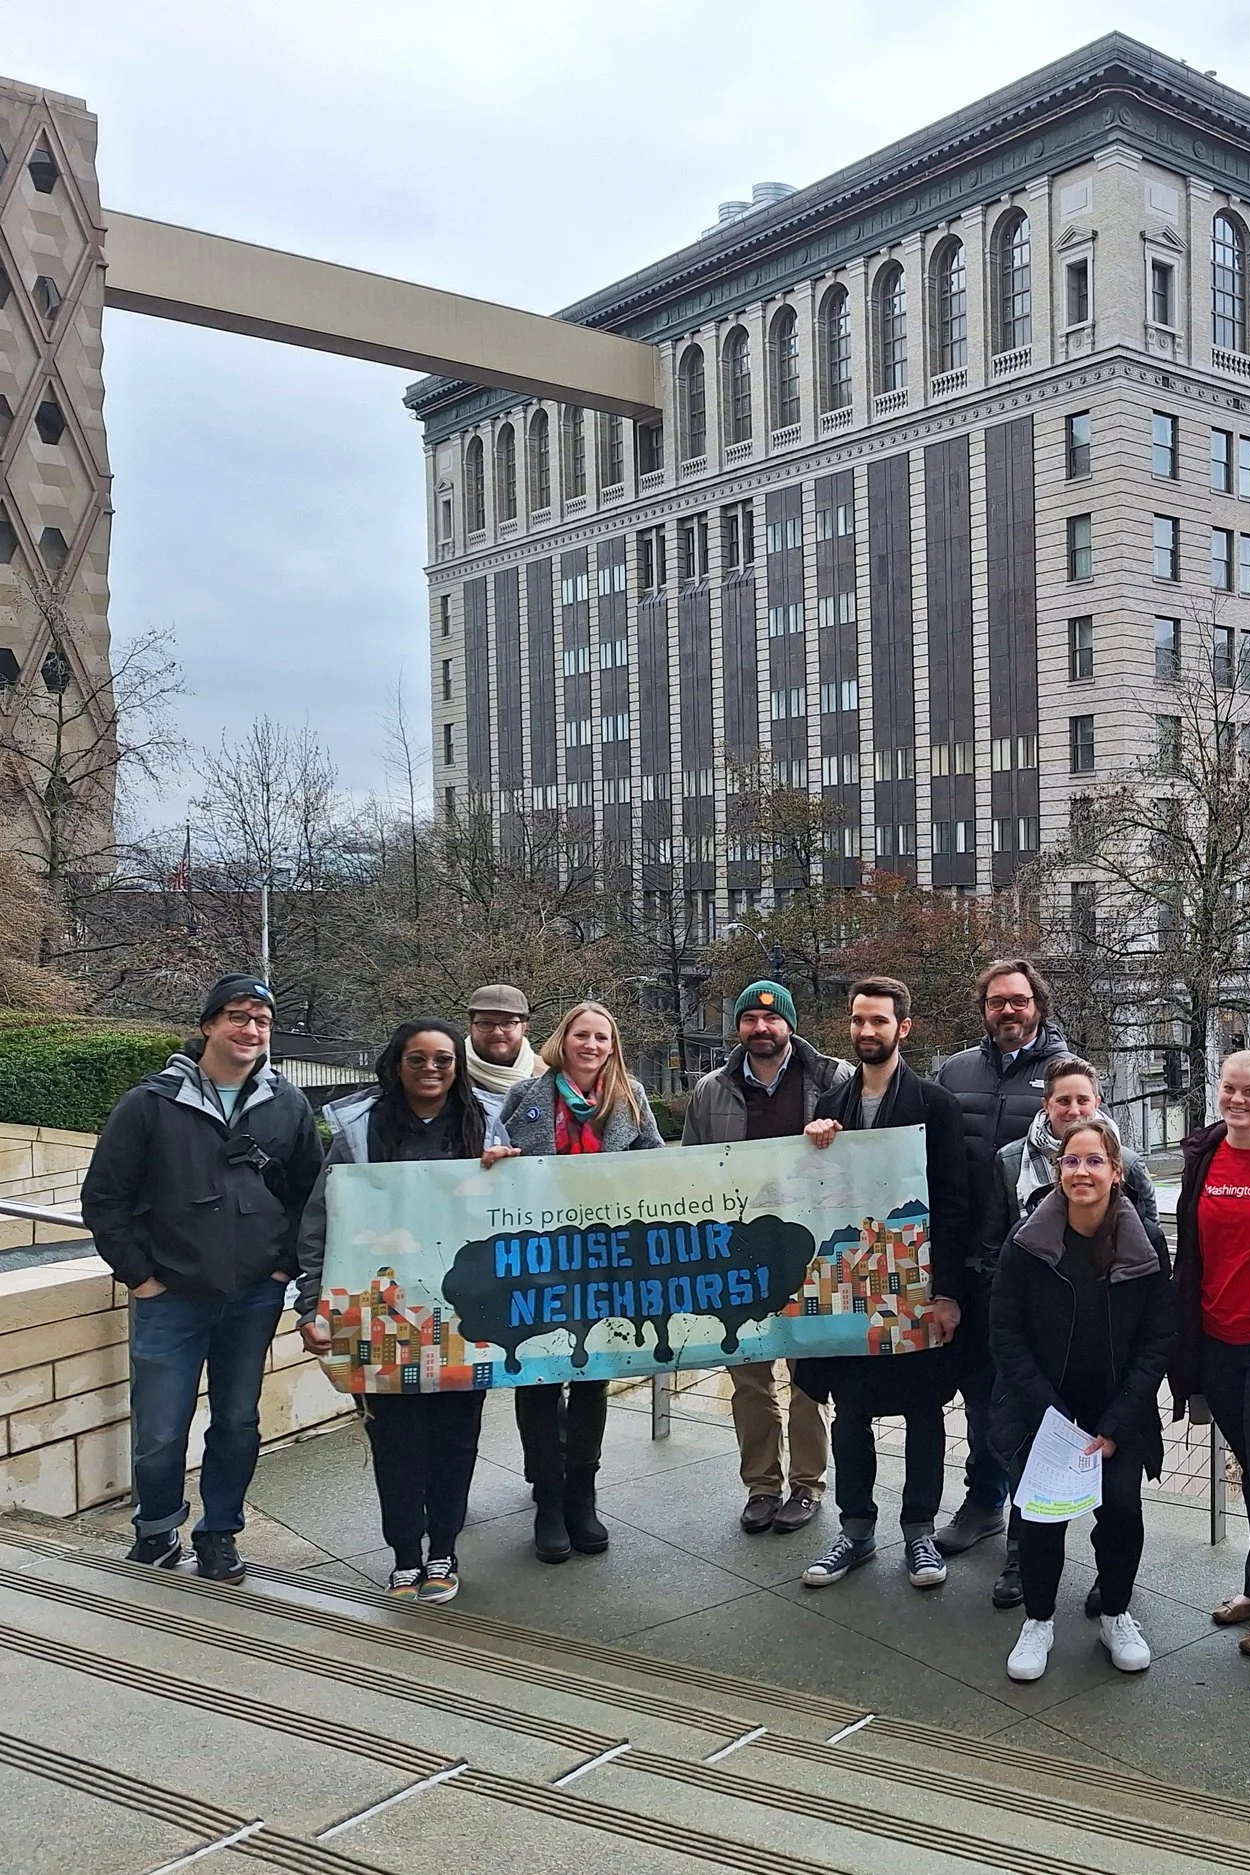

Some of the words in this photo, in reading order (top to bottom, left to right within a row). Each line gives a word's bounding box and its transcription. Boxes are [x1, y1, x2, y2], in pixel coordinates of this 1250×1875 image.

[486, 1207, 533, 1228] This
[541, 1204, 611, 1229] project
[616, 1202, 632, 1220] is
[637, 1195, 714, 1218] funded
[722, 1192, 749, 1217] by
[494, 1230, 633, 1278] HOUSE
[646, 1222, 734, 1266] OUR
[509, 1265, 770, 1328] NEIGHBORS!
